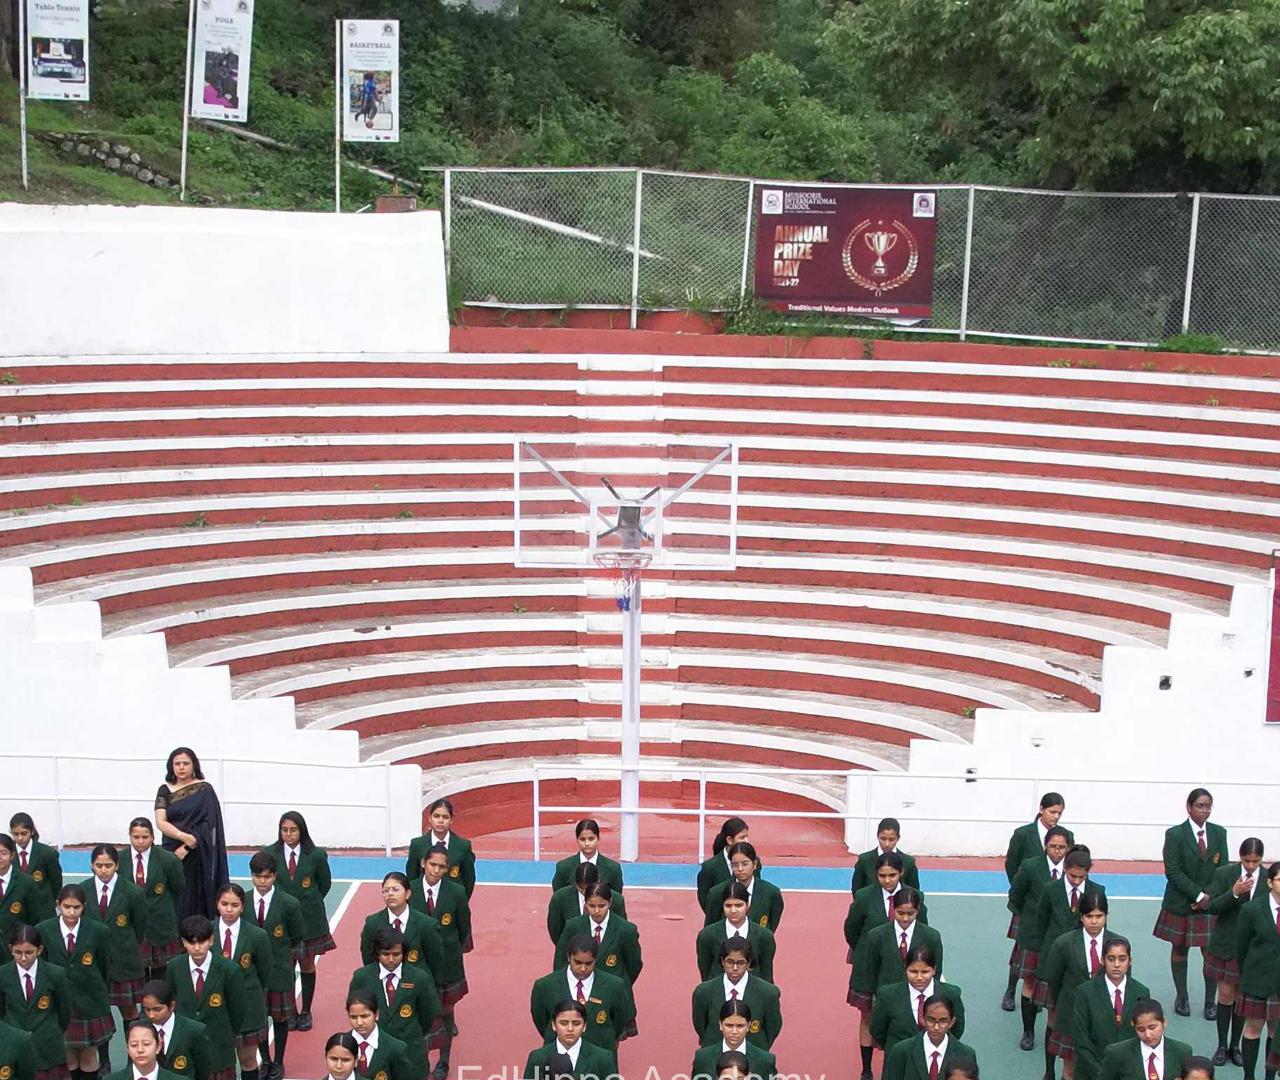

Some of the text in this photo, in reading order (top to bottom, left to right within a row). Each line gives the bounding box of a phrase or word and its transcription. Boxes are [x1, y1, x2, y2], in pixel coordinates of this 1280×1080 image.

[775, 225, 830, 243] ANNUAL
[774, 243, 813, 260] PRIZE
[773, 260, 800, 276] DAY
[787, 304, 822, 312] Traditional
[873, 306, 899, 314] Outlook
